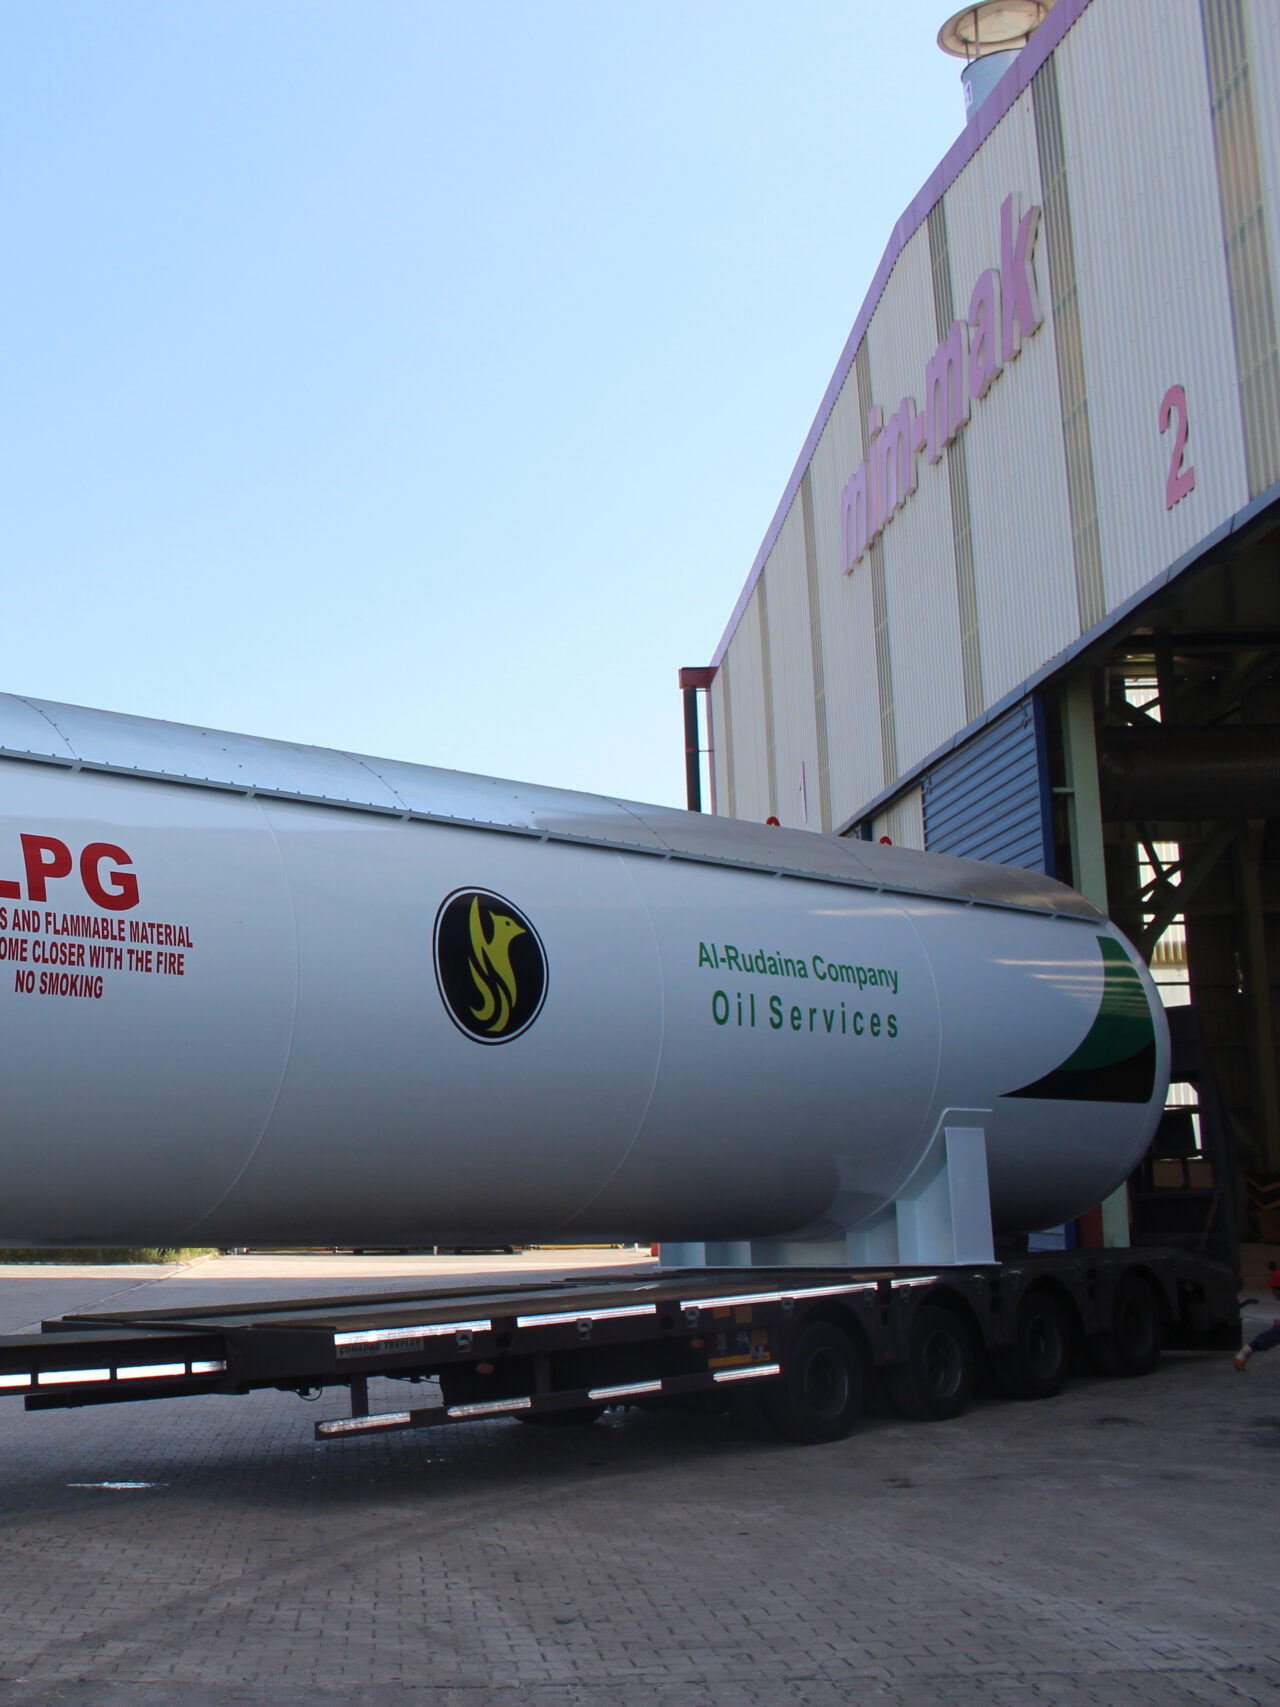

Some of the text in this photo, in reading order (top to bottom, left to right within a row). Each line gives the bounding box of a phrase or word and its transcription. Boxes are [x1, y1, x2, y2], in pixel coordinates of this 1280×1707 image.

[1159, 384, 1195, 511] 2
[12, 908, 41, 933] AND
[45, 911, 126, 942] FLAMMABLE
[129, 920, 194, 948] MATERIAL
[32, 940, 85, 967] CLOSER
[89, 945, 123, 970] WITH
[127, 949, 153, 973] THE
[156, 951, 186, 976] FIRE
[698, 941, 899, 995] Al-Rudaina Company
[15, 969, 104, 999] NO SMOKING
[711, 989, 898, 1039] Oil Services
